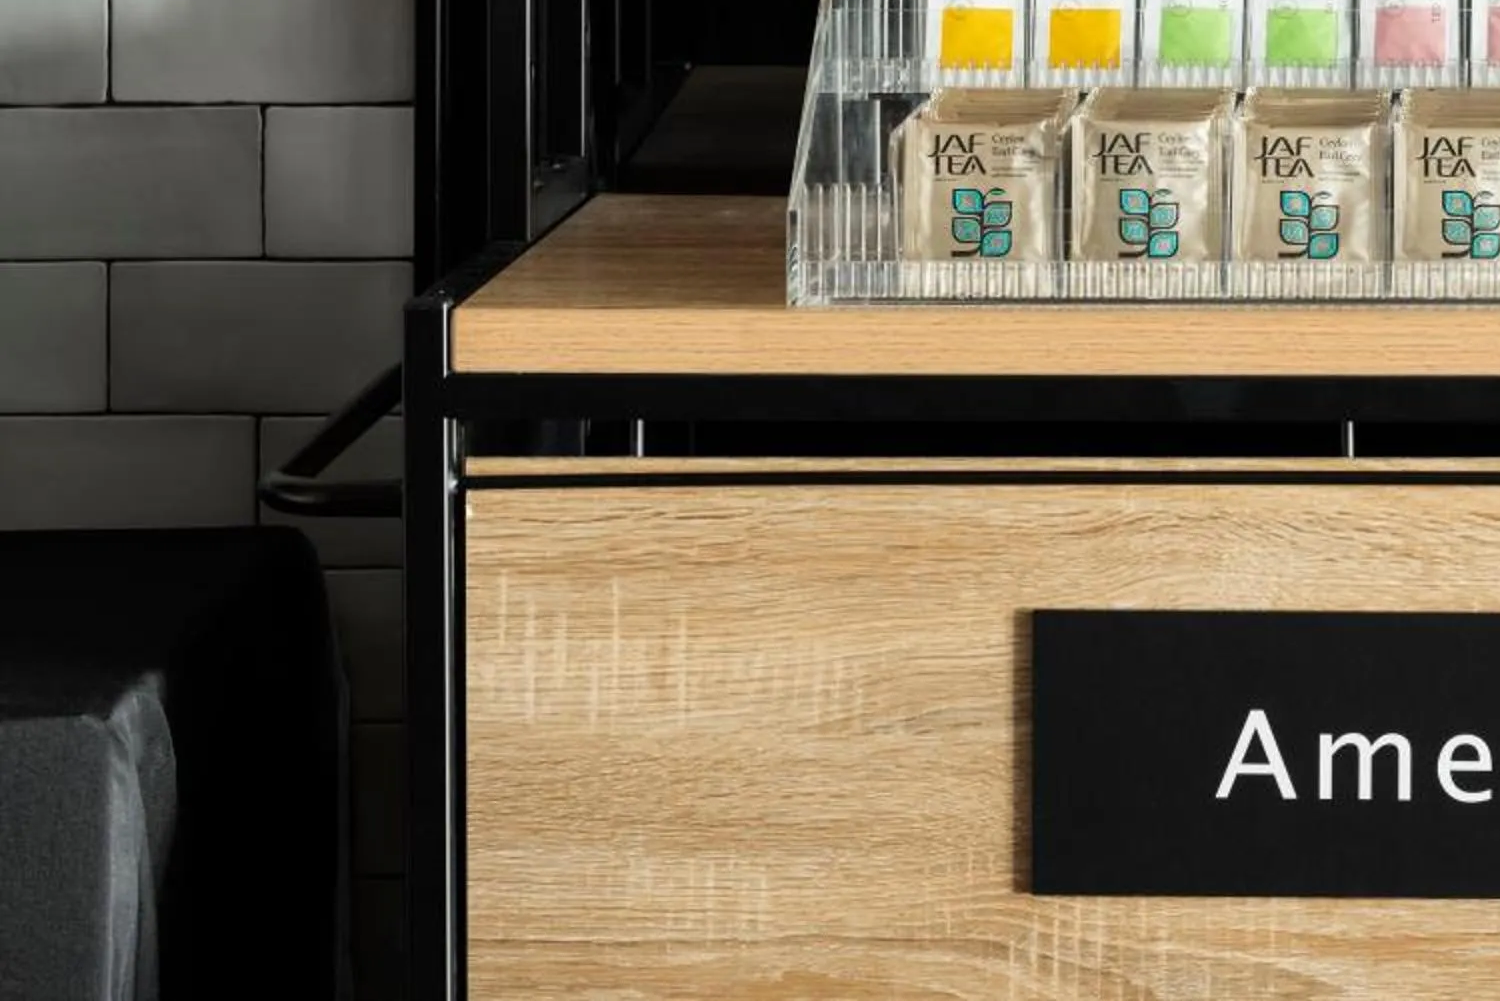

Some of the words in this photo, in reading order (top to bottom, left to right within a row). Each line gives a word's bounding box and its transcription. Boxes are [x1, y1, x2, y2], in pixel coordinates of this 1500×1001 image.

[928, 132, 985, 157] JAF
[1093, 132, 1153, 157] JAF
[1254, 136, 1313, 159] JAF
[1417, 136, 1473, 159] JAF
[934, 155, 987, 175] TEA
[1099, 155, 1153, 176] TEA
[1261, 157, 1315, 178] TEA
[1423, 157, 1476, 178] TEA
